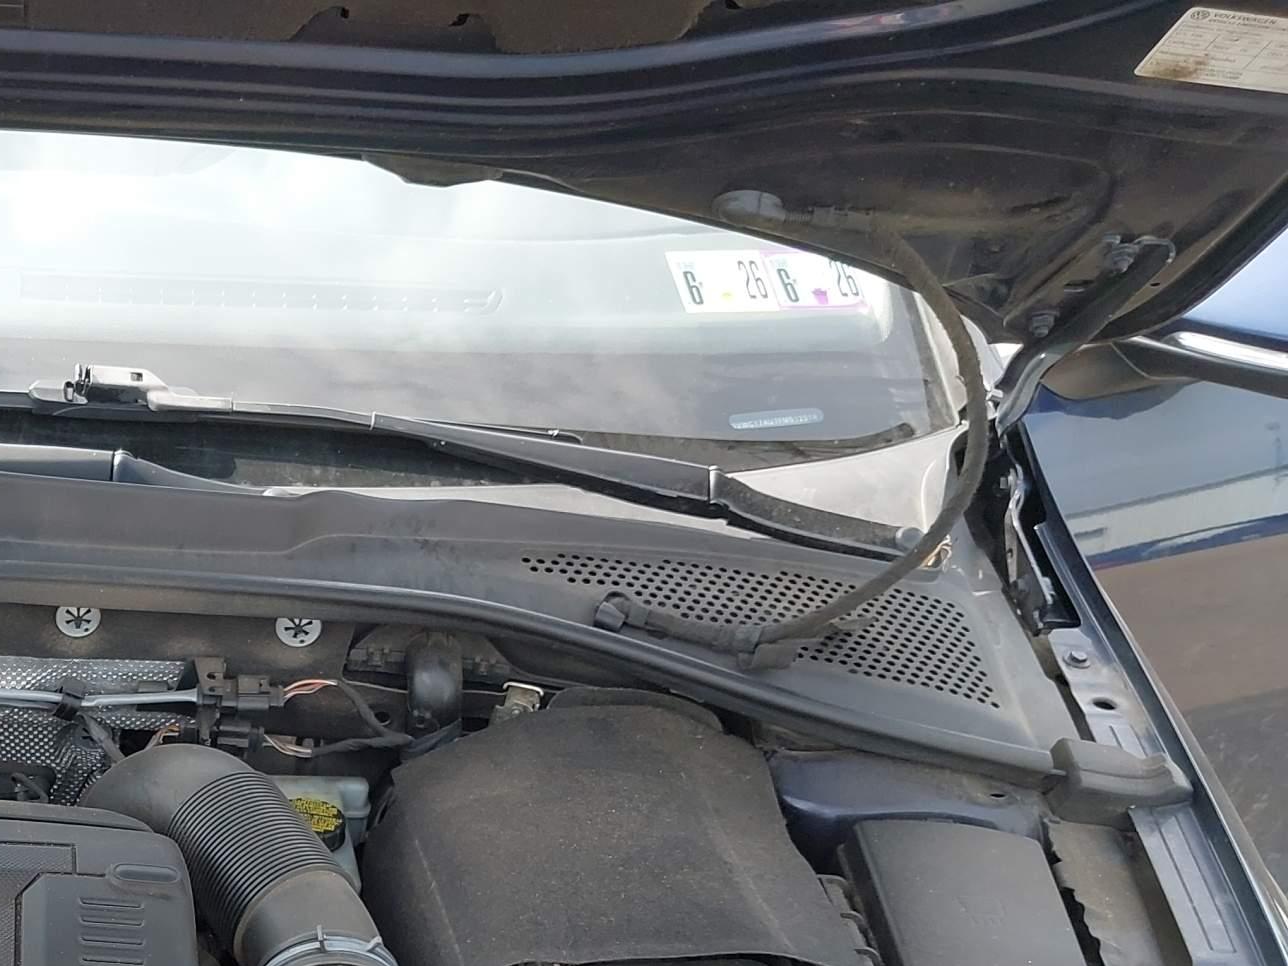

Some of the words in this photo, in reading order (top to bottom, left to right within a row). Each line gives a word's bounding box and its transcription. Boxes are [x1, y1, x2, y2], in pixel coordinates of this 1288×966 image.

[1213, 13, 1278, 25] VOLKSWAGEN
[682, 271, 704, 305] 6
[737, 260, 769, 299] 26
[776, 268, 800, 303] 6
[828, 260, 860, 297] 26
